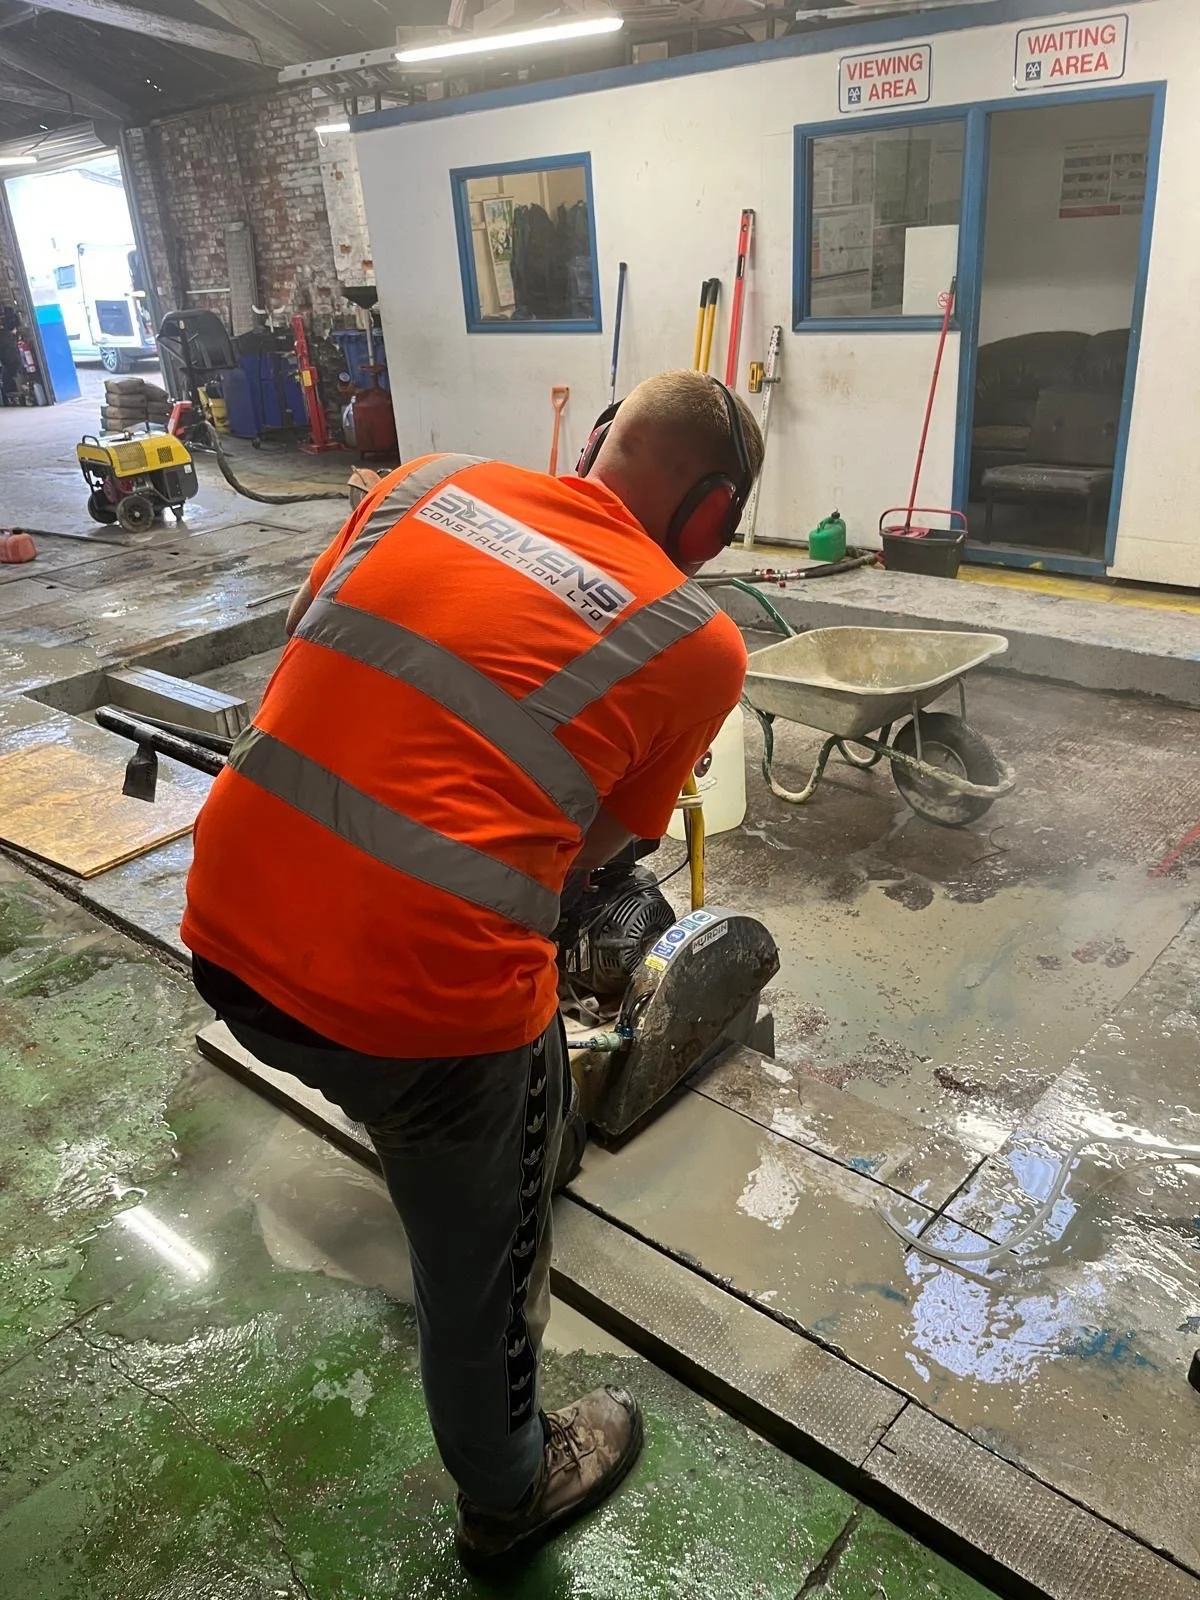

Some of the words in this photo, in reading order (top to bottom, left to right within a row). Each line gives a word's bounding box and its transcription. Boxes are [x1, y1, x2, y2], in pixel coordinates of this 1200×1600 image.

[1028, 24, 1116, 55] WAITING
[846, 53, 923, 81] VIEWING
[1050, 52, 1109, 77] AREA
[868, 78, 917, 101] AREA
[419, 507, 560, 585] CONSTRUCTION
[566, 590, 603, 621] LTD
[431, 493, 628, 613] SCRIVENS
